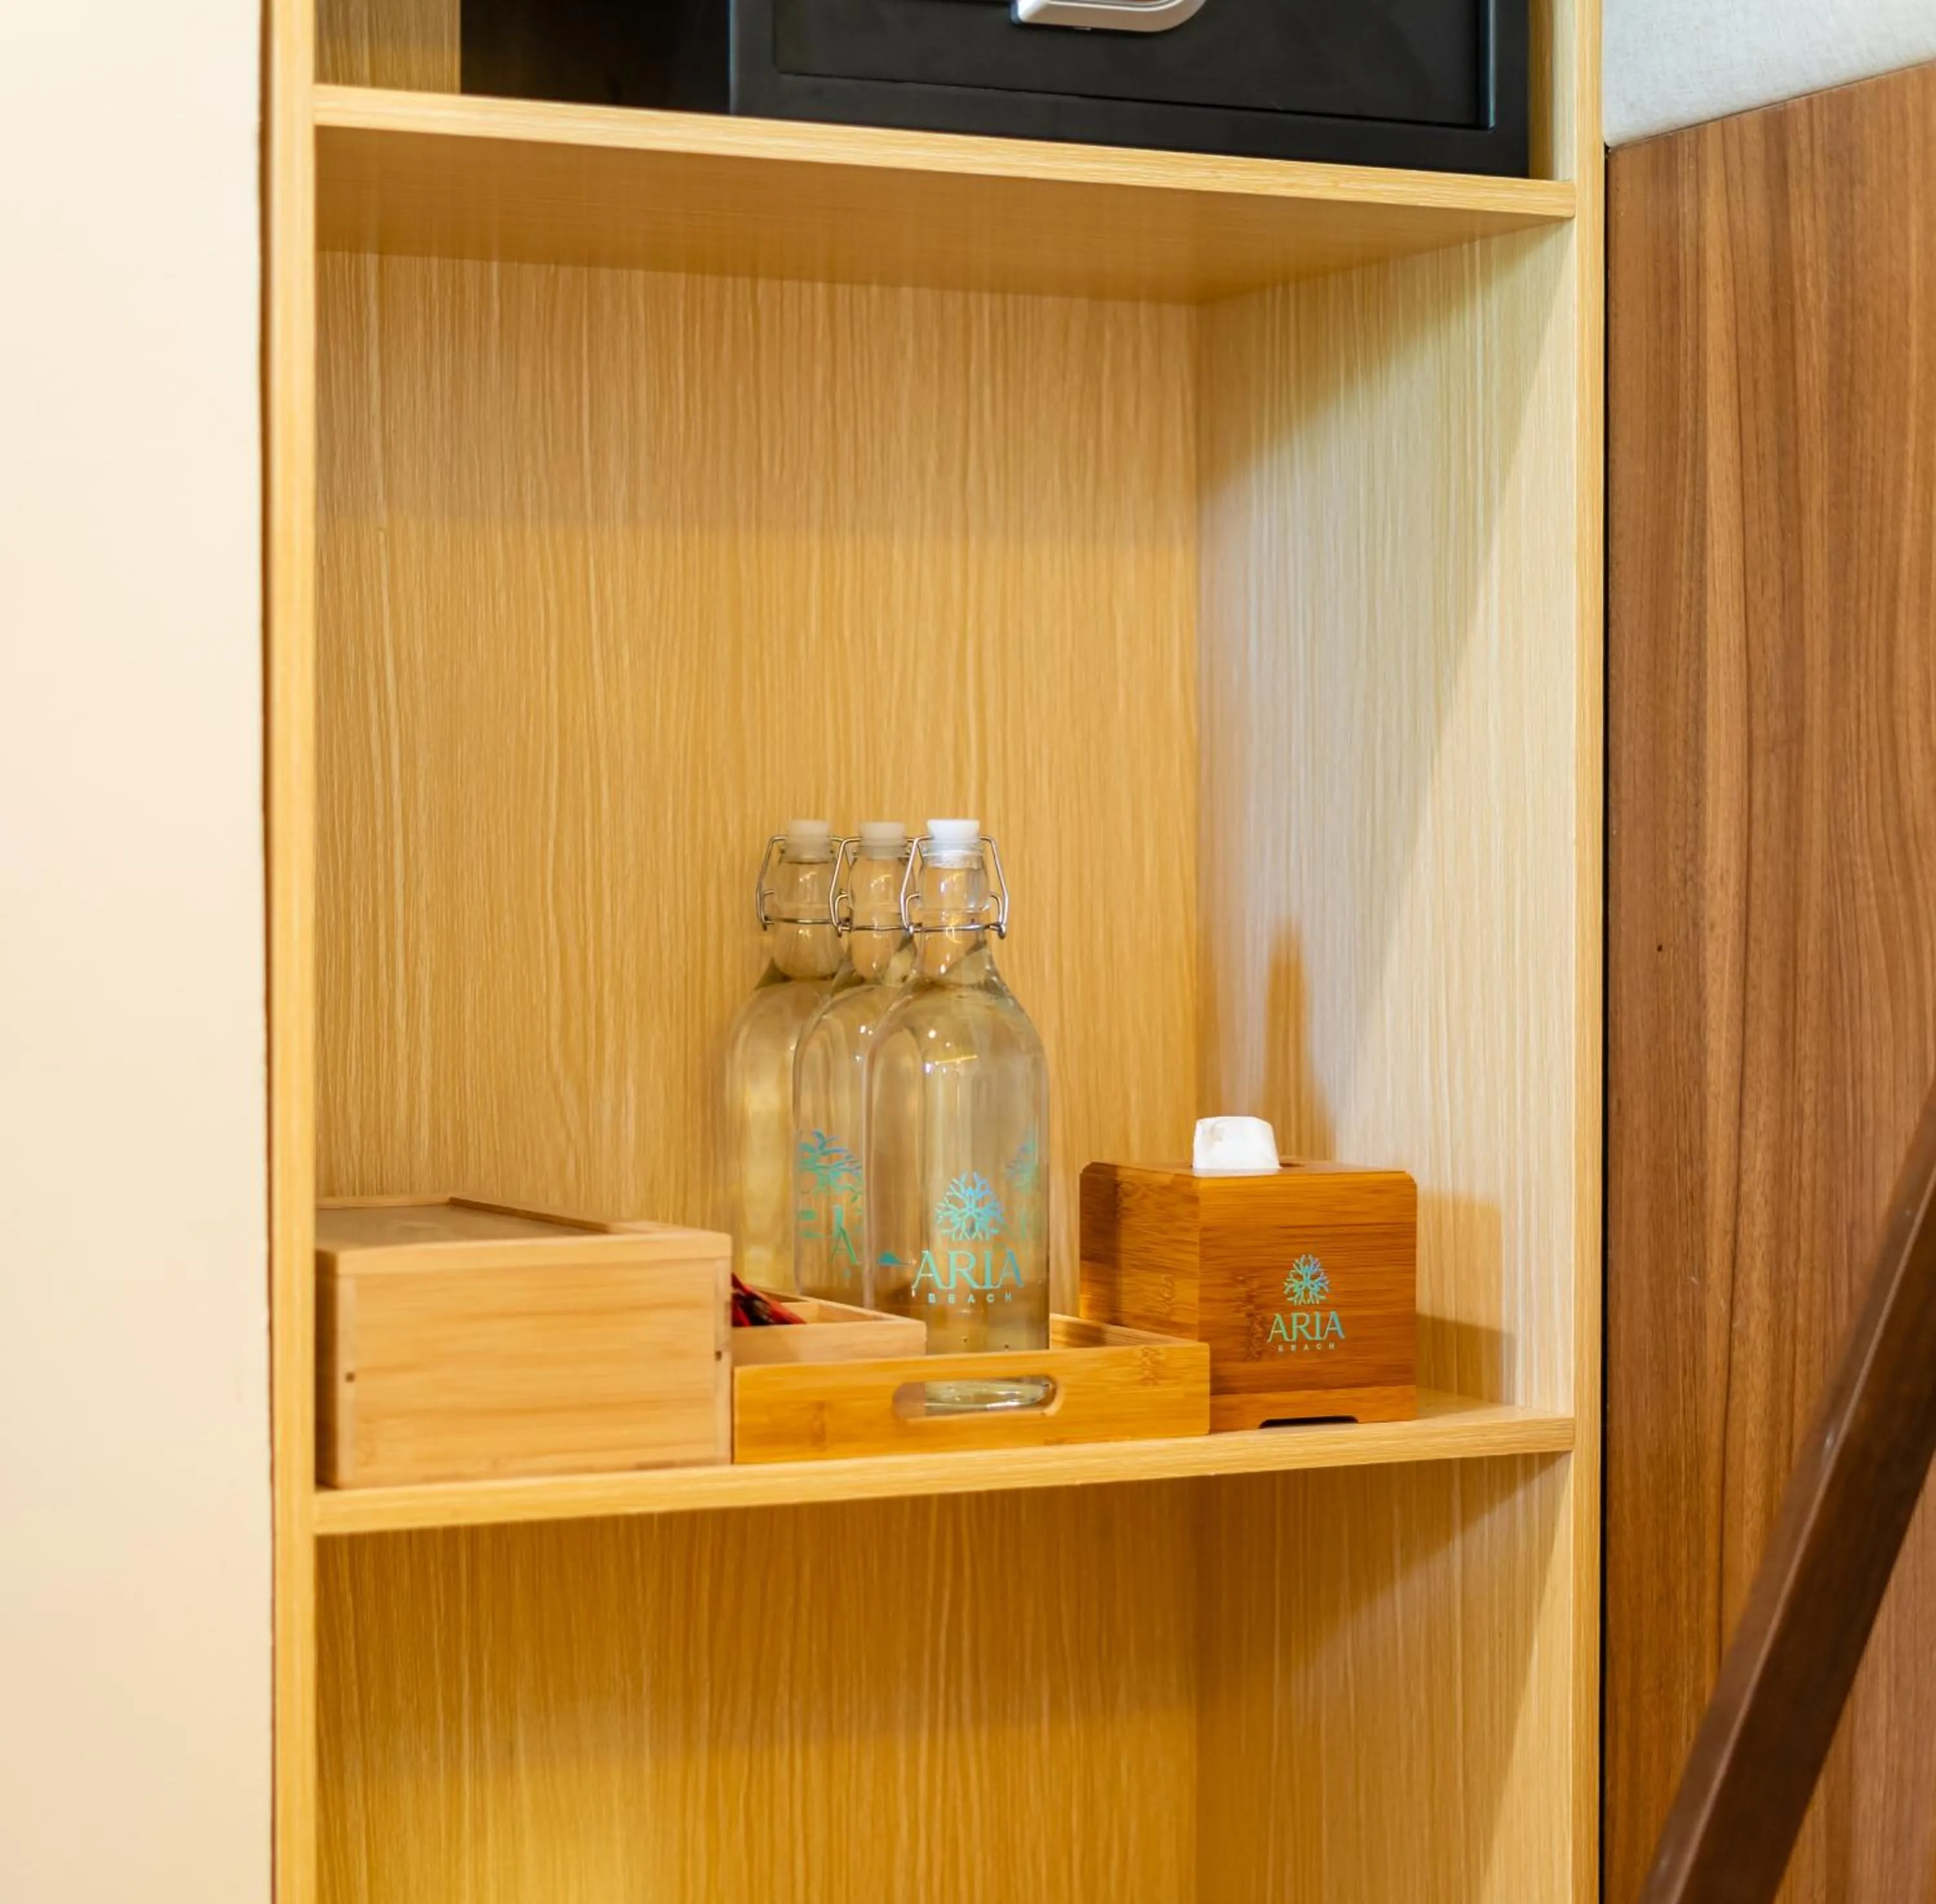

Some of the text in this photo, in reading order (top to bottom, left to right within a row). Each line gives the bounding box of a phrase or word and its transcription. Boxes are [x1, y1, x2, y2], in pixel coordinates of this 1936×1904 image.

[911, 1250, 1024, 1290] ARIA
[928, 1291, 1013, 1304] BEACH
[1267, 1311, 1346, 1342] ARIA
